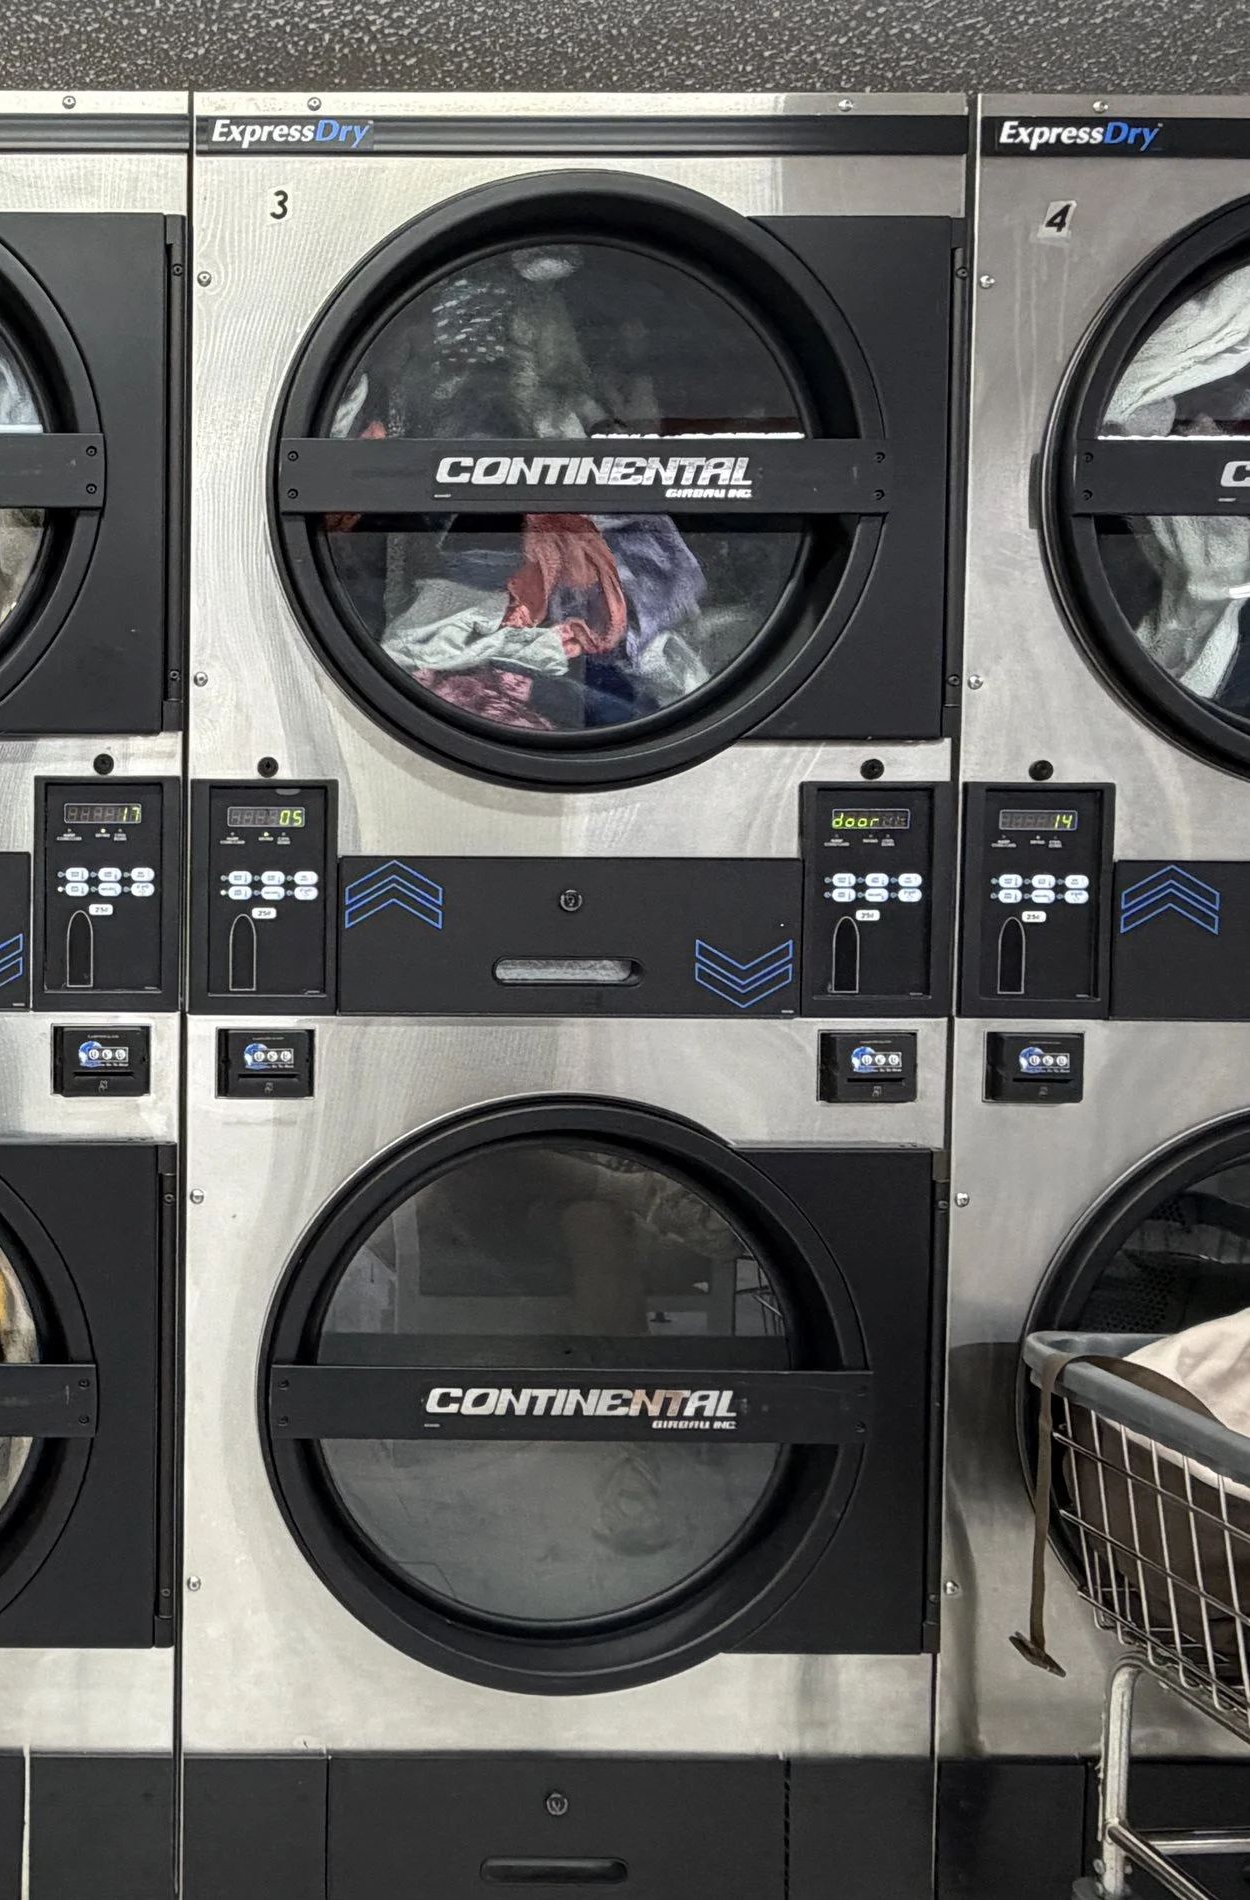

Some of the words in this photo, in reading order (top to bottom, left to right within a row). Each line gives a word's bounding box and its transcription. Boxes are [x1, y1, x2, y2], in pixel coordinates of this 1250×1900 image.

[212, 119, 370, 148] ExpressDry
[1000, 121, 1159, 151] ExpressDry
[270, 190, 289, 219] 3
[1045, 203, 1071, 232] 4
[436, 457, 752, 485] CONTINENTAL
[123, 806, 141, 822] 17
[279, 810, 302, 825] 05
[832, 813, 879, 829] door
[1054, 815, 1073, 829] 14
[425, 1388, 737, 1417] CONTINENTAL
